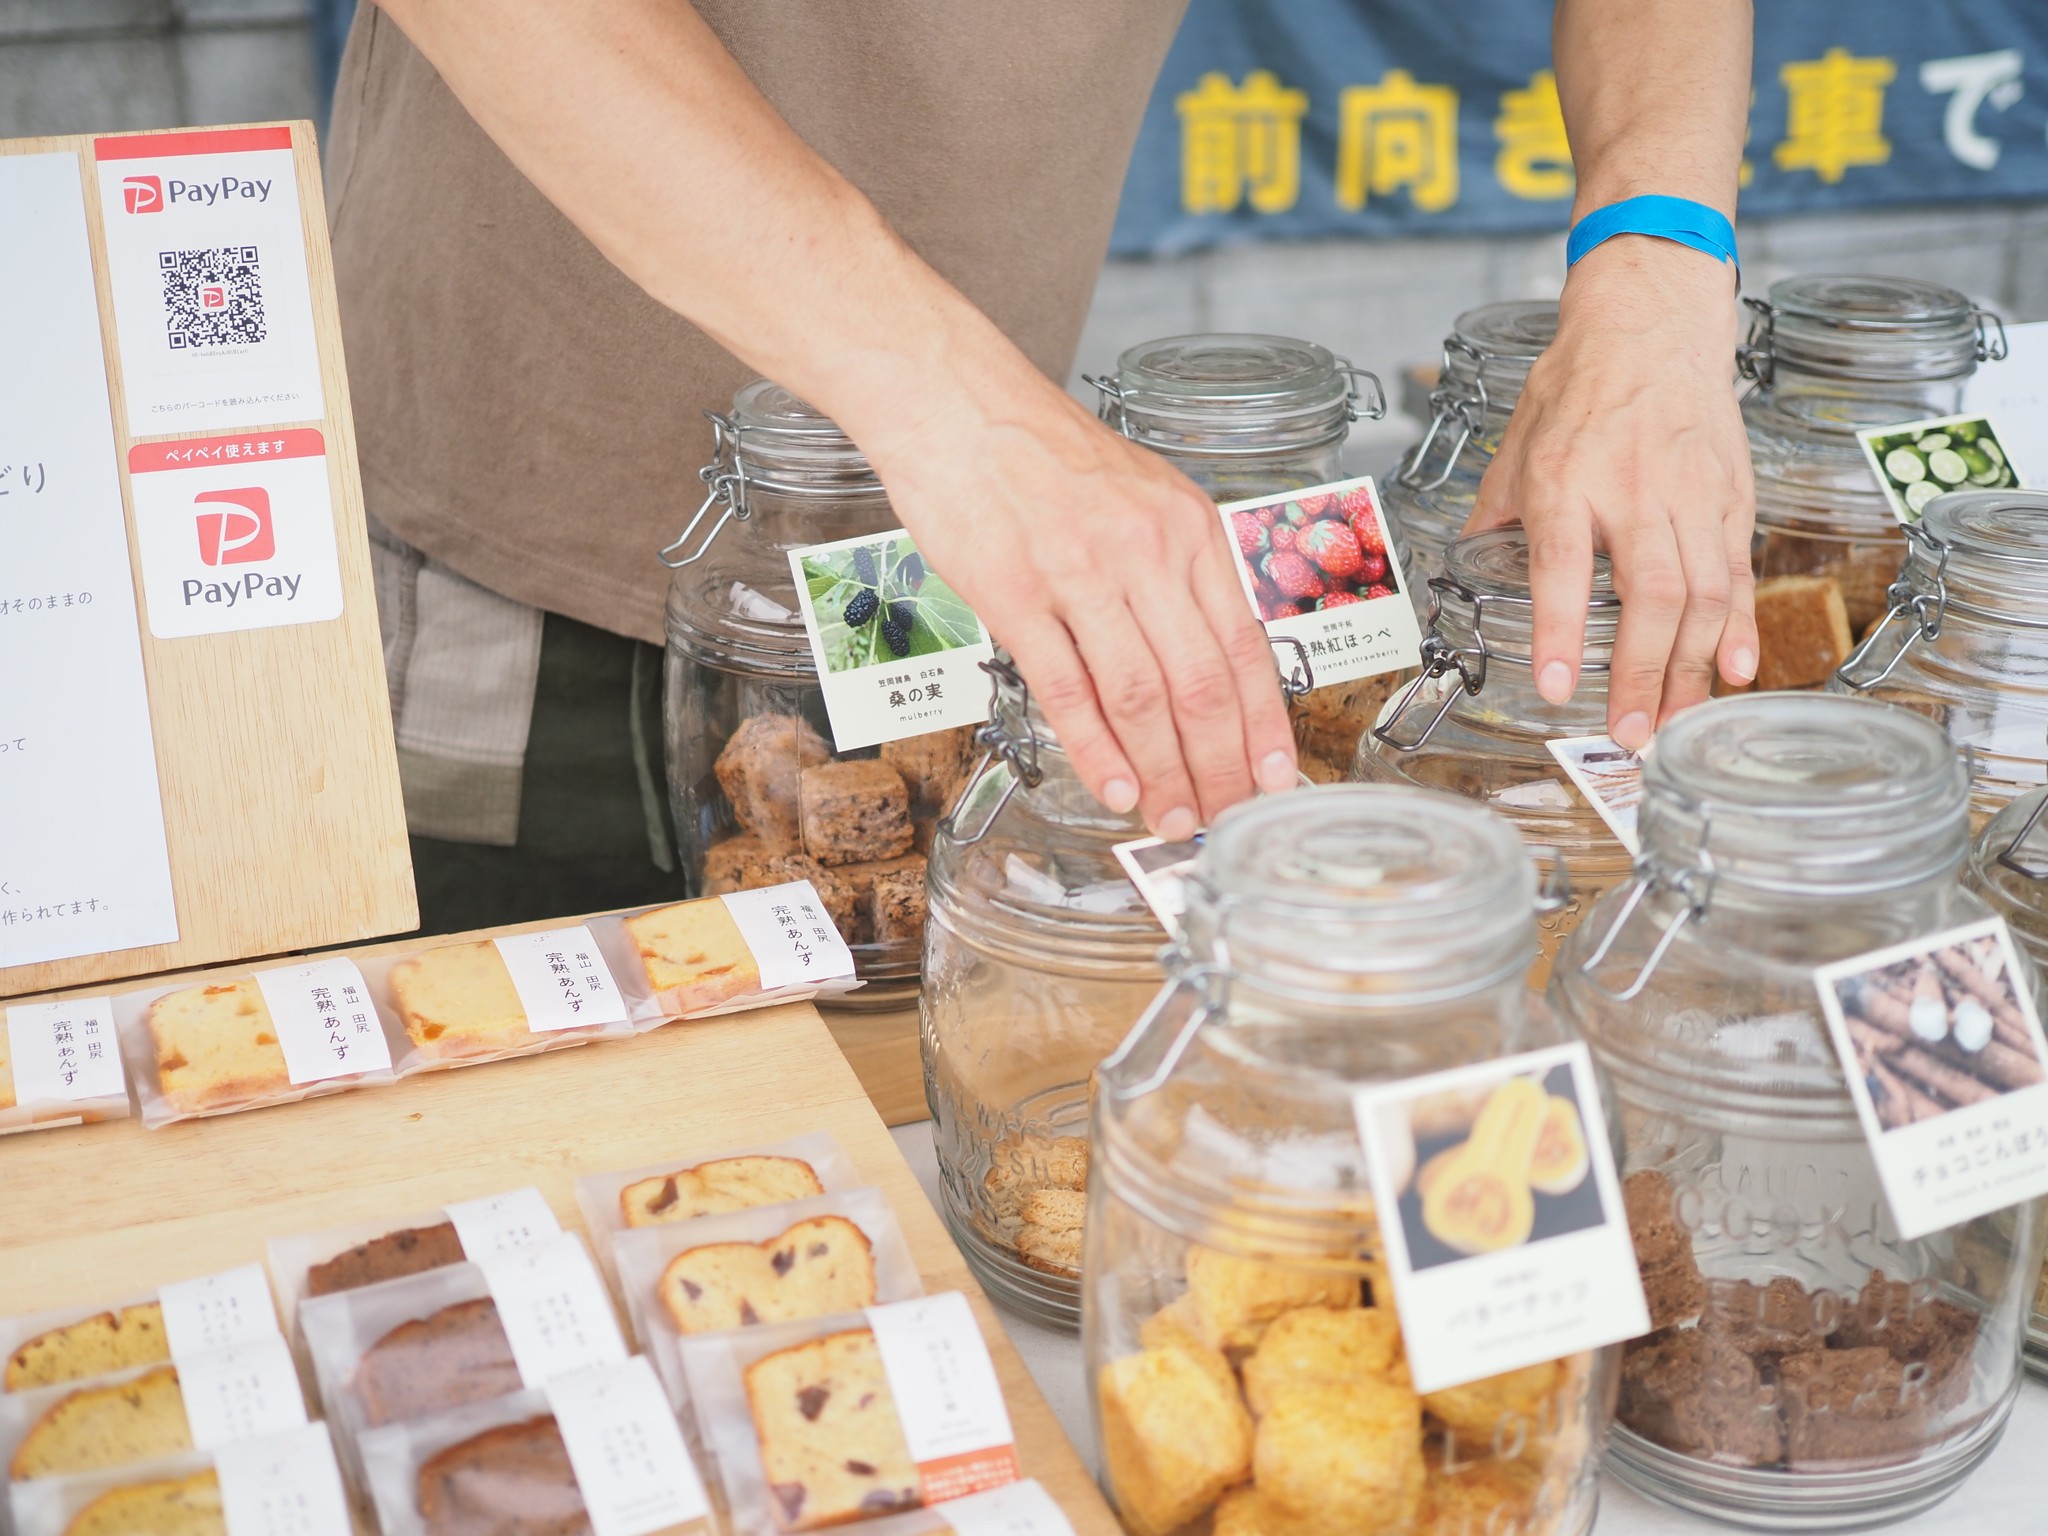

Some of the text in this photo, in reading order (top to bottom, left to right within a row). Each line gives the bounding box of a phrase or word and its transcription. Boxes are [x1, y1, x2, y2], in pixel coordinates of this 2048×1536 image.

[1177, 47, 2026, 214] 前向き車で
[168, 176, 272, 206] PayPay
[165, 440, 285, 462] ペイペイ使えます
[182, 572, 302, 608] PayPay
[1351, 648, 1399, 665] strawberry
[919, 667, 945, 680] 白石島
[889, 683, 944, 709] 桑の実
[899, 708, 943, 723] mulberry
[1, 897, 109, 926] 作られてます。
[800, 904, 818, 921] 福山
[771, 904, 813, 967] 完熟あんず
[575, 952, 592, 969] 福山
[545, 952, 583, 1013] 完熟あんず
[311, 987, 349, 1060] 完熟あんず
[342, 985, 371, 1034] 福山 田尻
[84, 1018, 99, 1035] 福山
[53, 1020, 79, 1086] 完熟あんず
